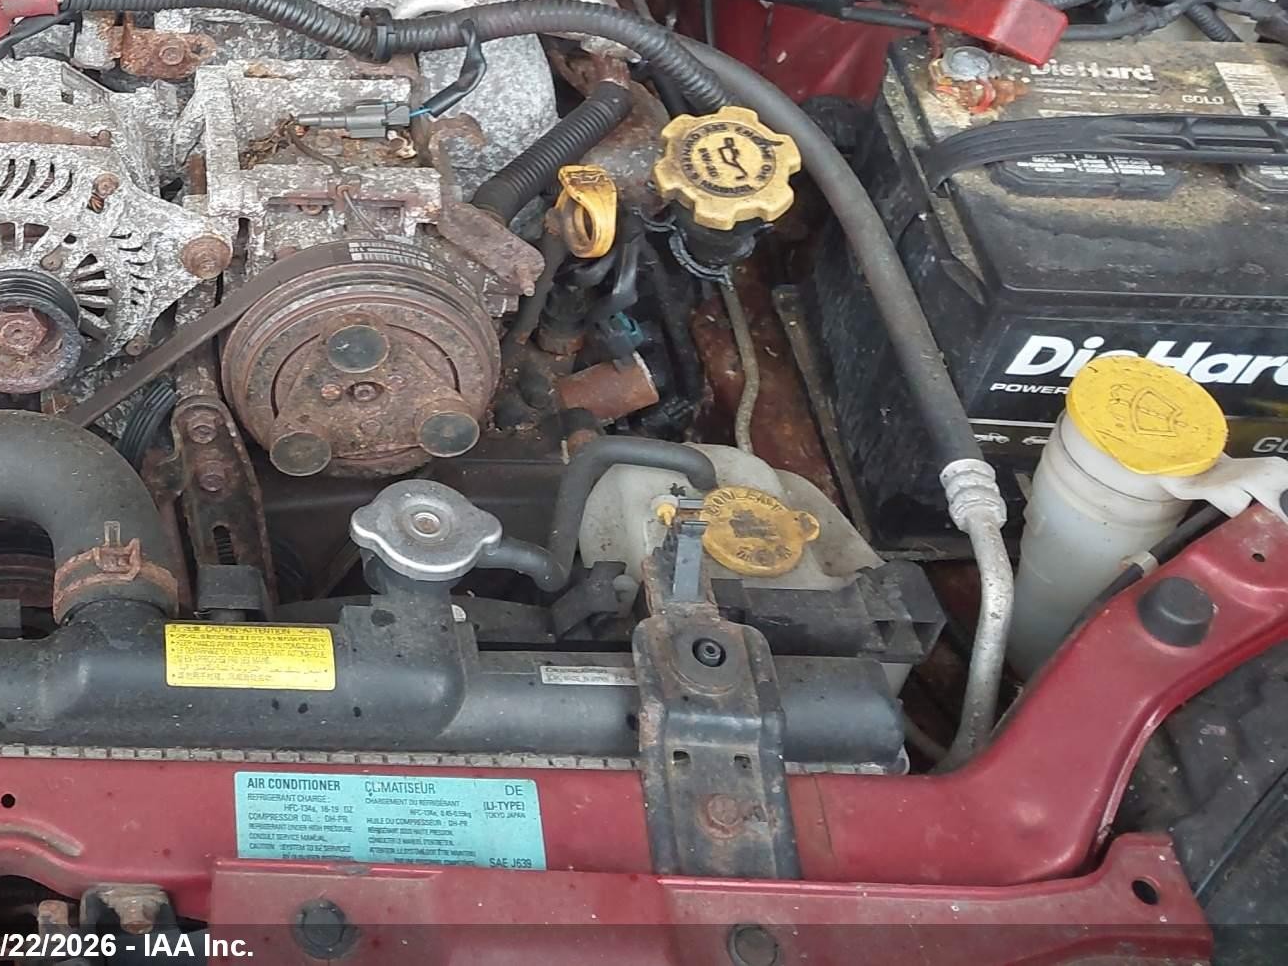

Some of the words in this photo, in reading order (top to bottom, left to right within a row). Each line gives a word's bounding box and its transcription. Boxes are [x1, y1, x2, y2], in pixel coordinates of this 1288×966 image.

[1181, 94, 1225, 106] GOLD
[247, 778, 265, 789] AIR
[268, 778, 341, 791] CONDITIONER
[505, 785, 524, 796] DE
[489, 857, 508, 868] SAE
